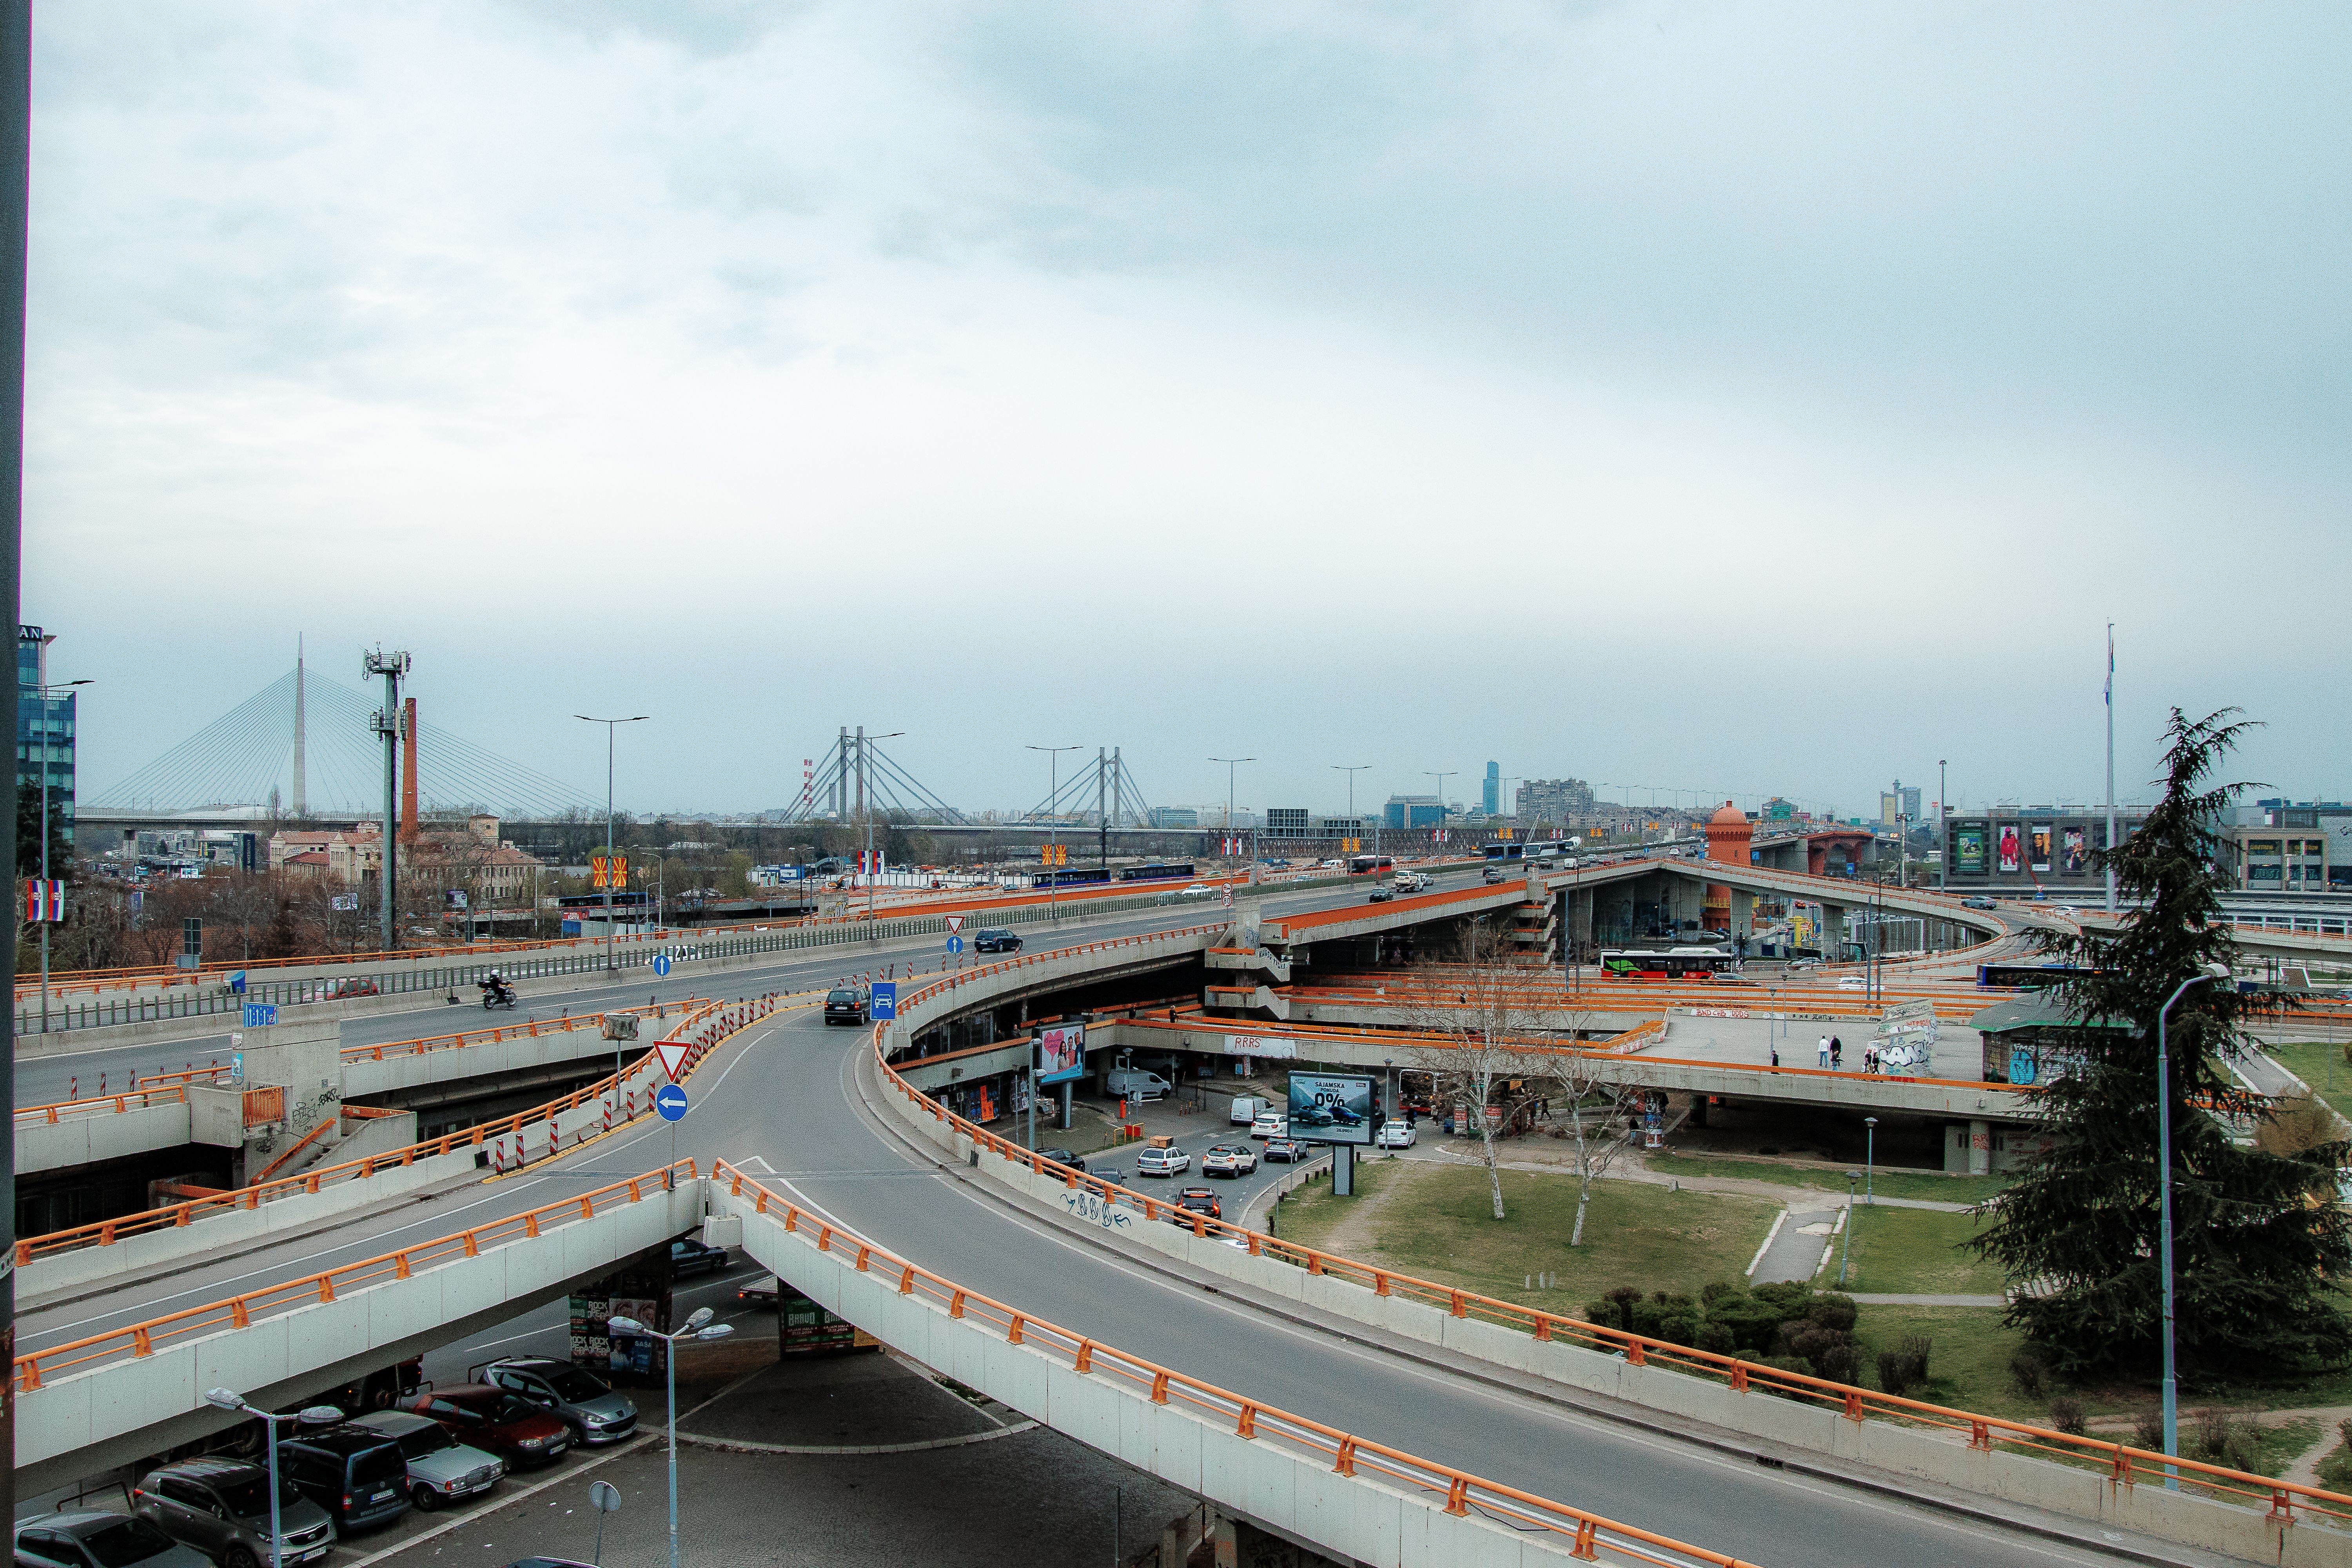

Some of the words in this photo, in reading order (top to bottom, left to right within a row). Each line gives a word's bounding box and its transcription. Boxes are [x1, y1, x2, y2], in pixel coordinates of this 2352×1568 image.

[1235, 1037, 1261, 1049] RRRS
[1315, 1093, 1345, 1107] 0%
[588, 1301, 608, 1309] ROCK
[589, 1336, 608, 1345] ROCK
